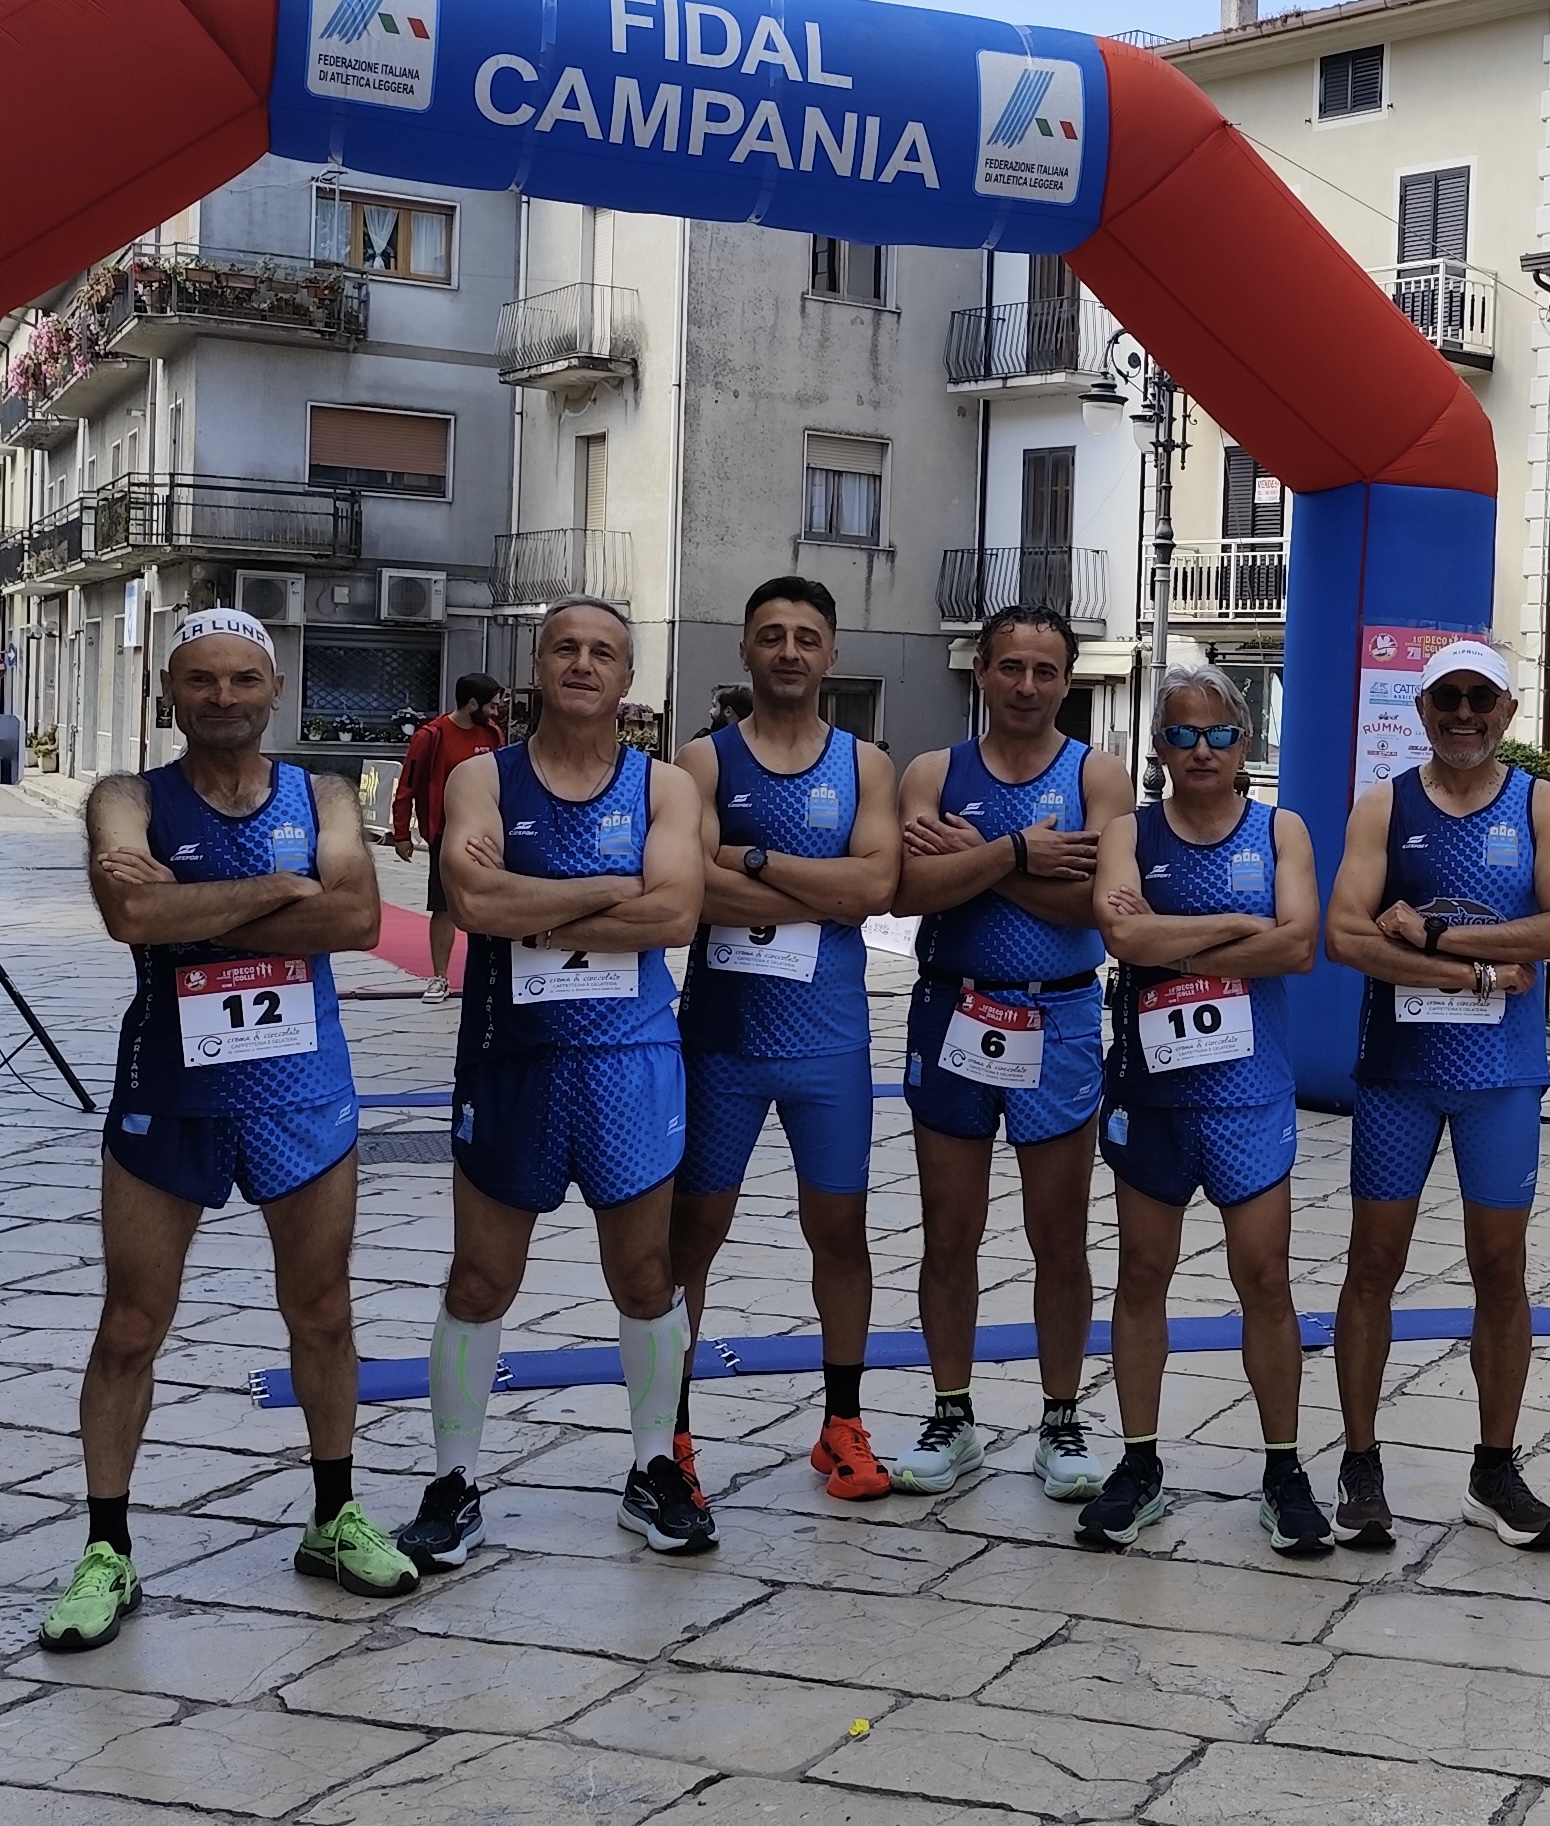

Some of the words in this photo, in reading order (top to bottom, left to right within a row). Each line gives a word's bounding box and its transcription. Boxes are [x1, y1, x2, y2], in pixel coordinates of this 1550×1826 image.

[611, 0, 852, 89] FIDAL
[318, 53, 379, 75] FEDERAZIONE
[380, 63, 420, 81] ITALIANA
[318, 69, 329, 82] DI
[329, 71, 371, 89] ATLETICA
[373, 78, 415, 96] LEGGERA
[474, 53, 941, 190] CAMPANIA
[985, 158, 1036, 174] FEDERAZIONE
[1036, 163, 1069, 178] ITALIANA
[984, 172, 993, 183] DI
[993, 173, 1028, 187] ATLETICA
[1029, 177, 1064, 191] LEGGERA
[181, 624, 204, 643] LA
[212, 619, 267, 647] LUNA
[1425, 635, 1447, 645] DECO
[1424, 644, 1443, 653] COLL
[1393, 683, 1422, 695] CATTO
[1362, 722, 1412, 737] RUMMO
[234, 966, 255, 975] DECO
[560, 948, 590, 970] 2
[1176, 984, 1195, 992] DECO
[222, 990, 283, 1029] 12
[1167, 1003, 1222, 1039] 10
[980, 1029, 1007, 1059] 6
[130, 1035, 142, 1089] ARIANO
